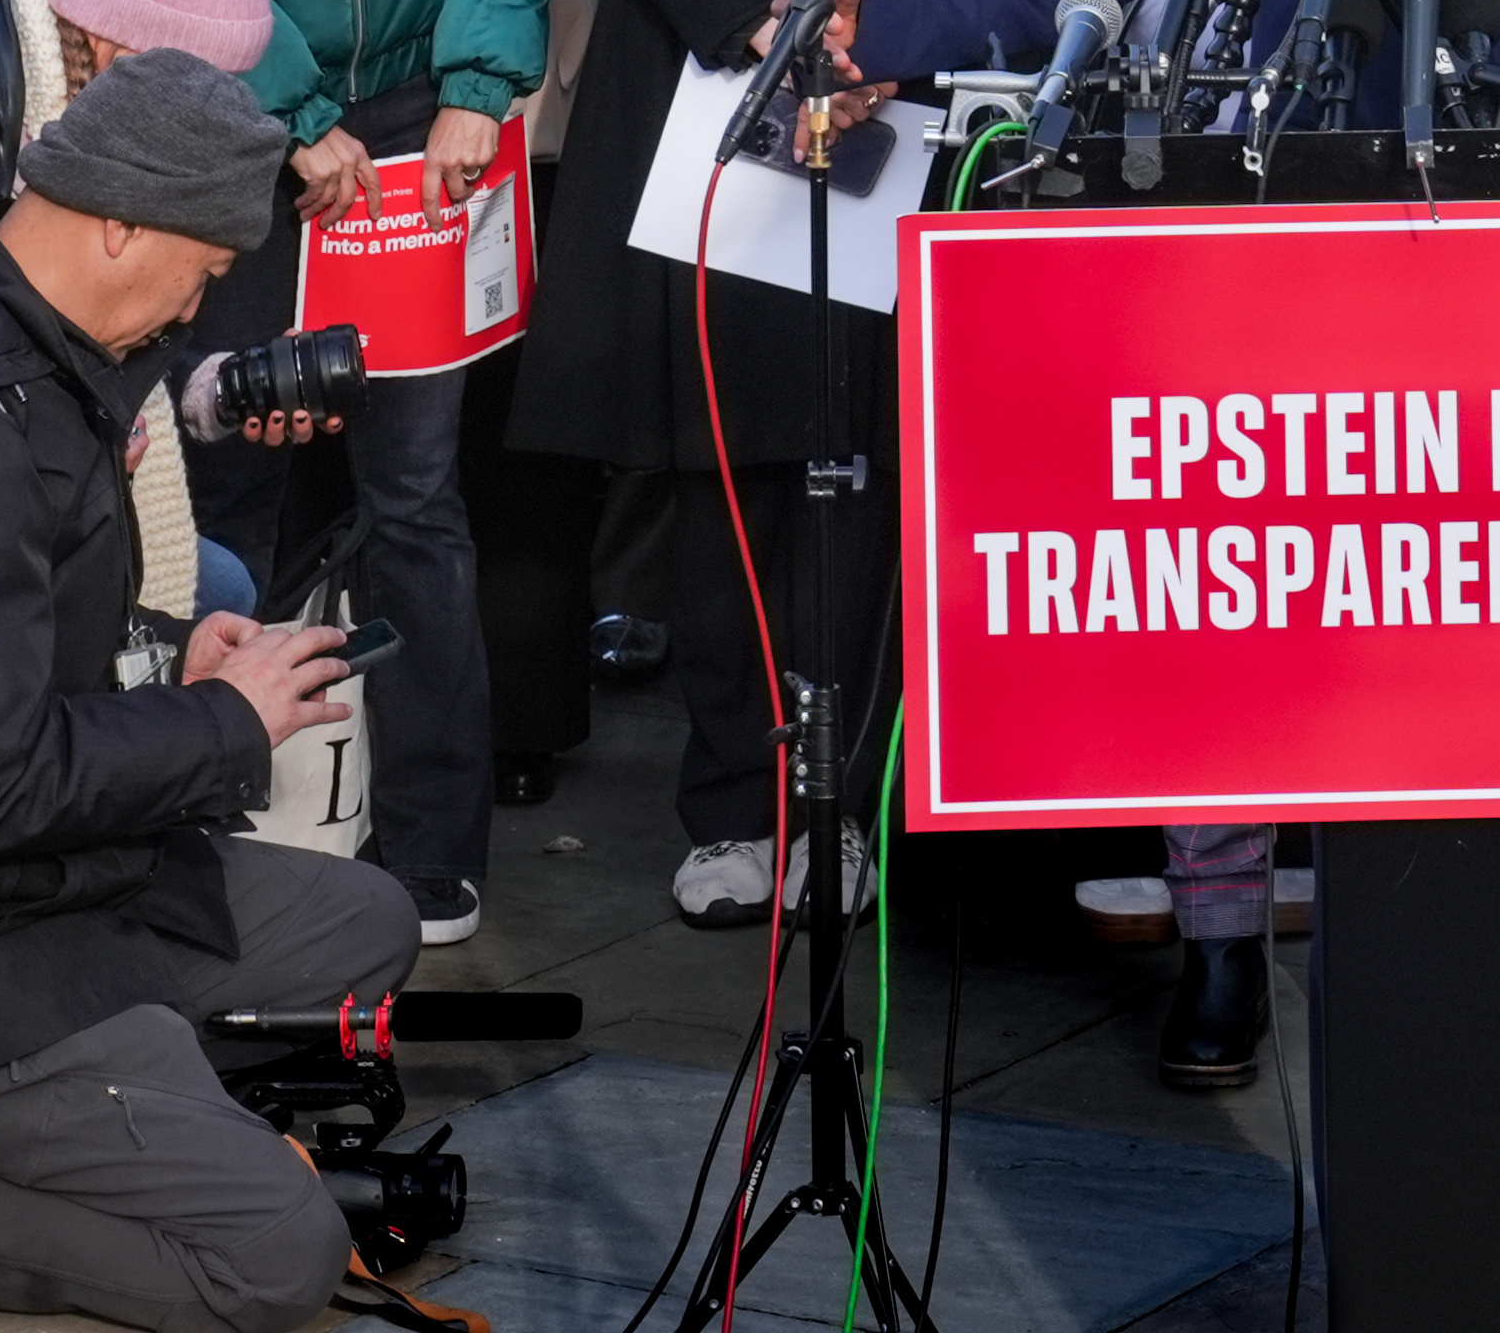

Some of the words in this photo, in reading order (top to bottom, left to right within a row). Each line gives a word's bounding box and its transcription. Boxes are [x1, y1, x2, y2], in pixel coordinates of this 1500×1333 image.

[393, 188, 414, 197] Prints
[327, 218, 373, 234] urn
[321, 235, 364, 255] into
[368, 240, 381, 255] a
[385, 224, 464, 253] memory.
[1110, 390, 1459, 501] EPSTEIN
